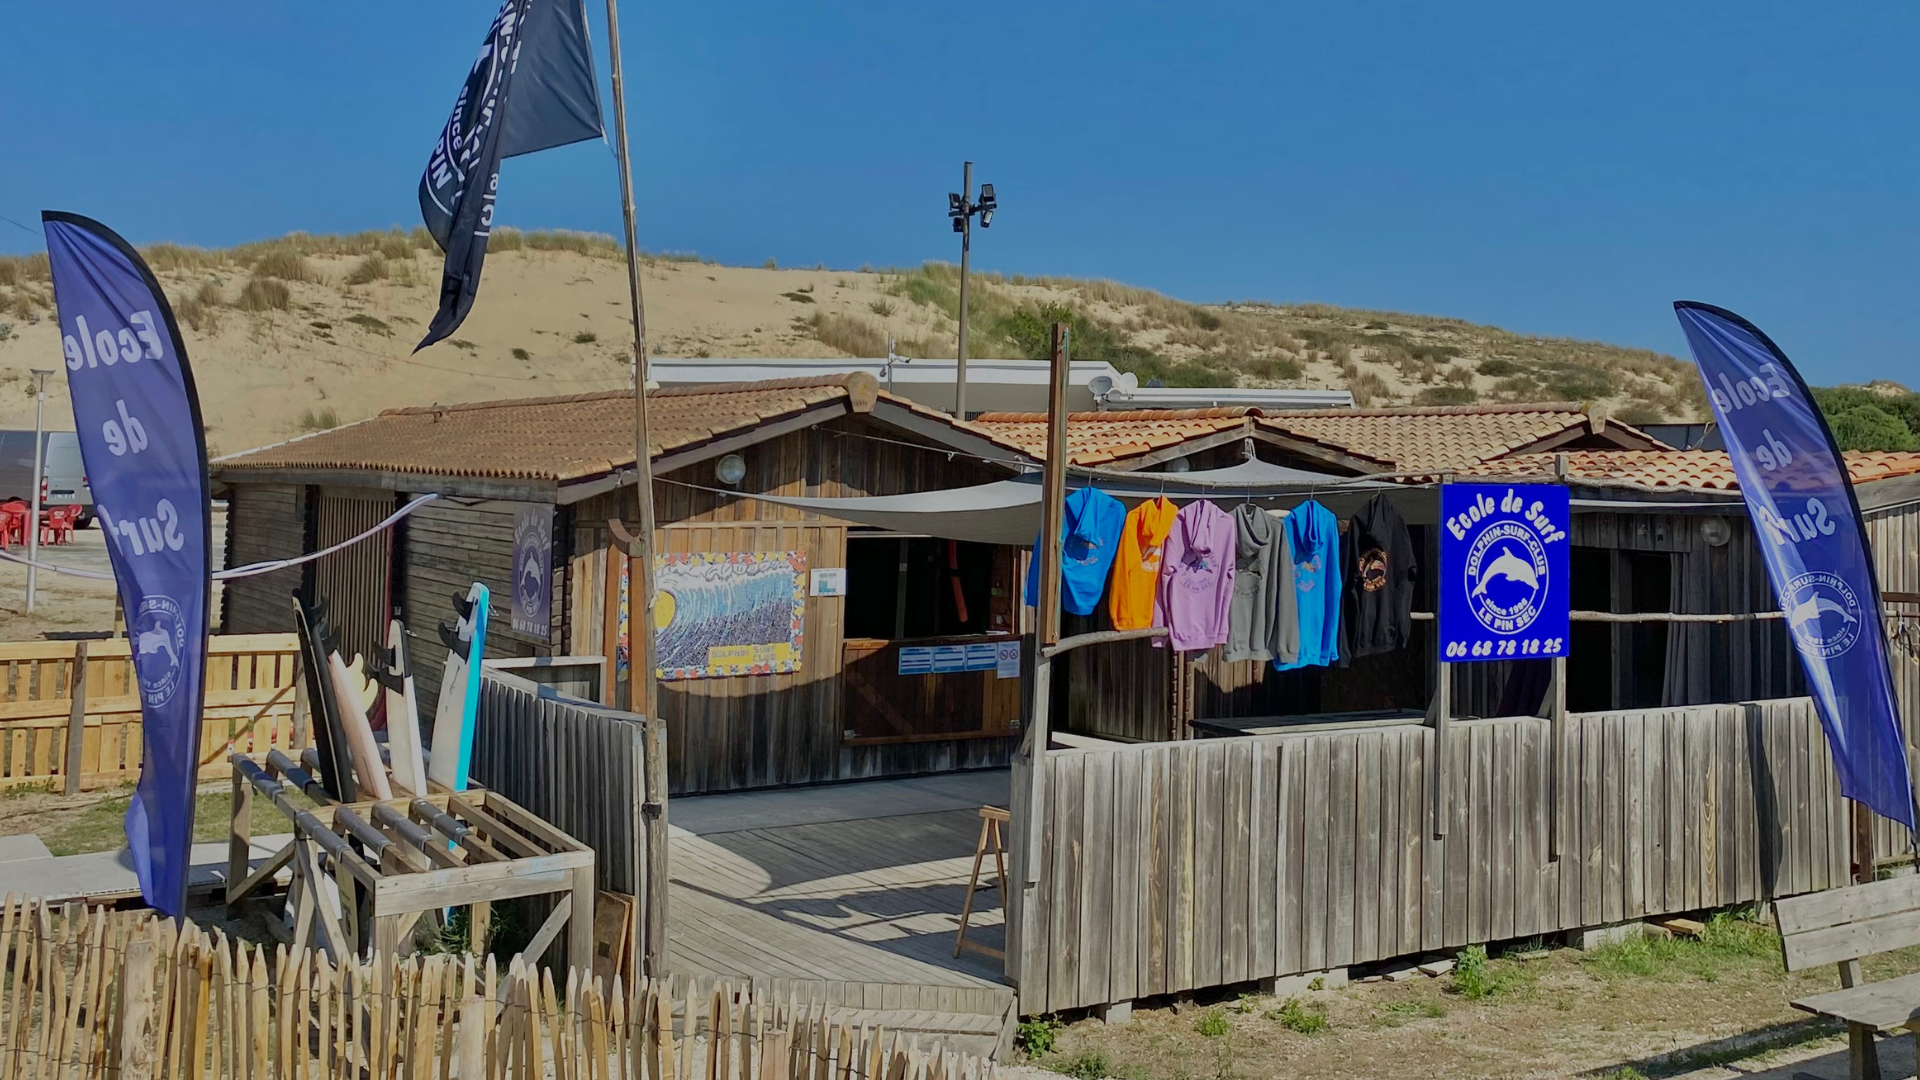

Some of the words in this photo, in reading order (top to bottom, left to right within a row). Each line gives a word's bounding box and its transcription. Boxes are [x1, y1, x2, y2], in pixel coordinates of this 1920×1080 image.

[1446, 493, 1495, 541] Ecole
[1500, 488, 1523, 513] de
[1525, 501, 1566, 544] Surf
[1468, 524, 1546, 576] DOLPHIN-SURF-CLUB
[1478, 607, 1493, 625] LE
[1493, 619, 1514, 631] PIN
[1515, 605, 1536, 628] SEC
[1485, 598, 1507, 616] since
[1446, 641, 1468, 657] 06
[1471, 640, 1493, 656] 68
[1497, 640, 1517, 656] 78
[1521, 638, 1540, 655] 18
[1542, 637, 1563, 654] 25
